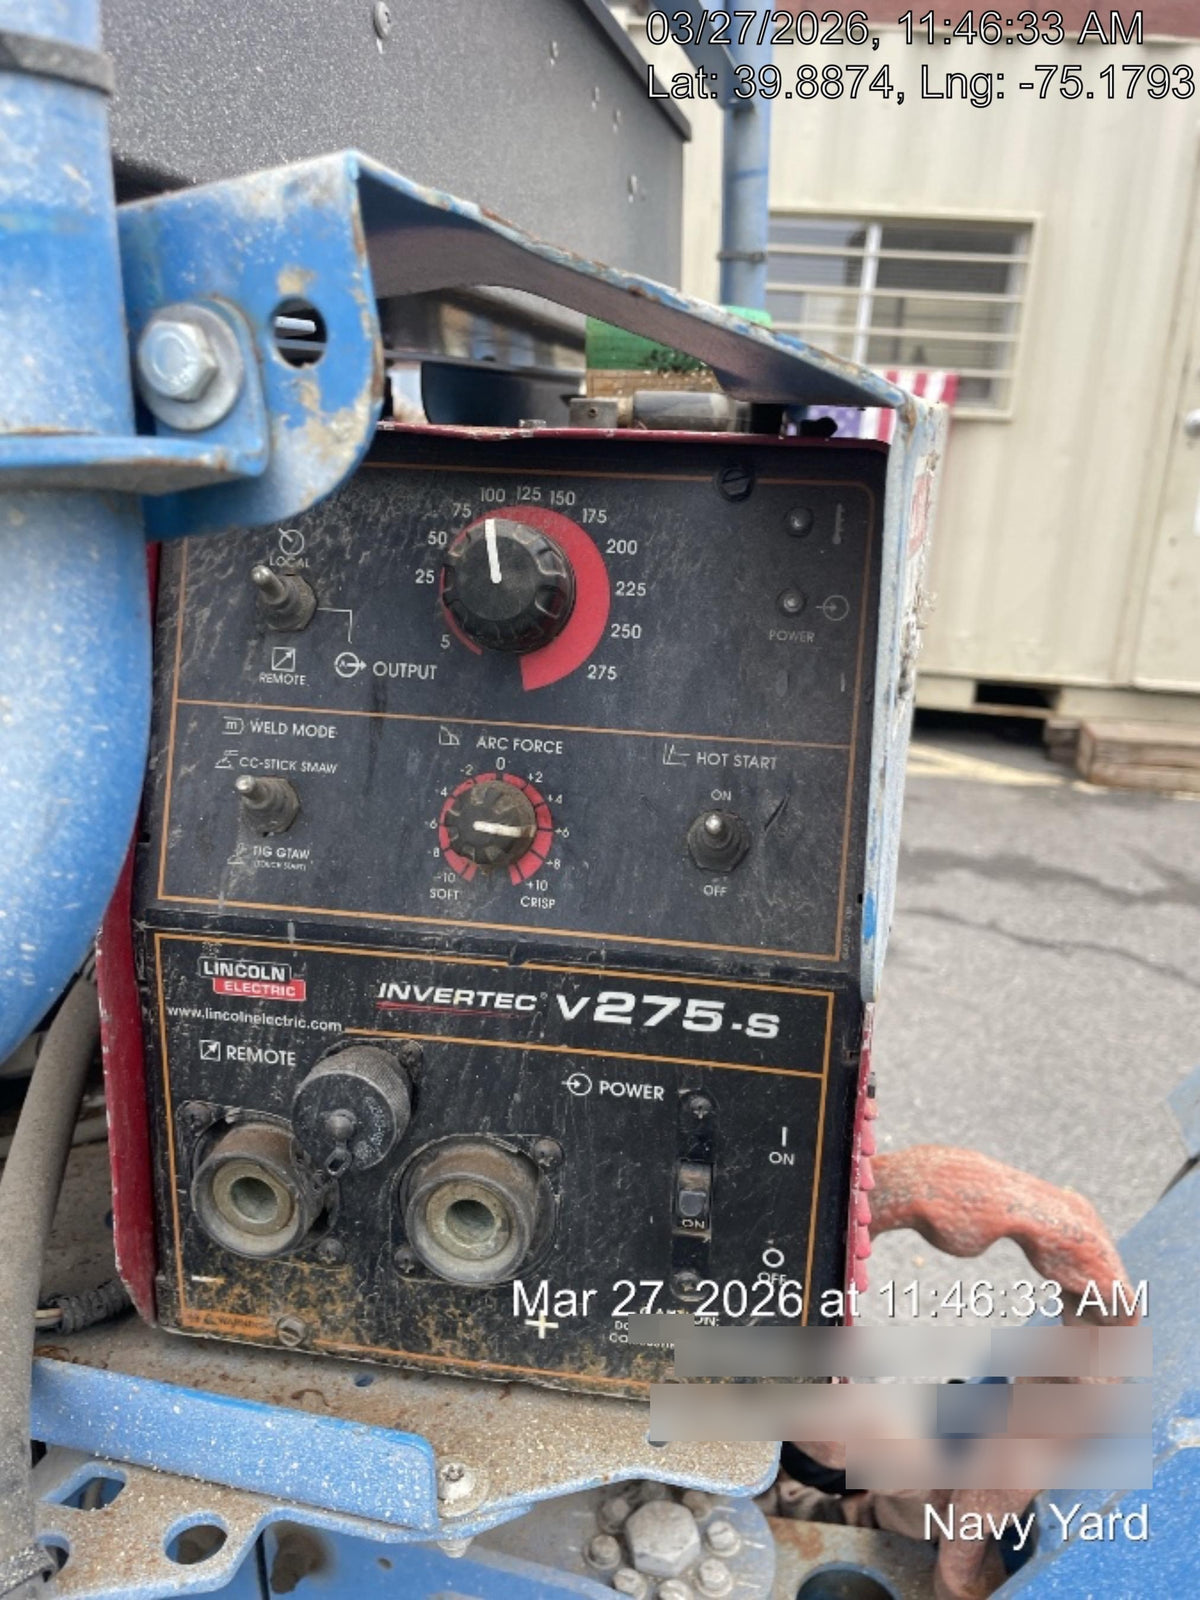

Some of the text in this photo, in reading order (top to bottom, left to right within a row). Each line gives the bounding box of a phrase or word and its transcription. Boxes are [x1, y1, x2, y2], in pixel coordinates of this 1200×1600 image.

[480, 487, 506, 502] 100
[516, 486, 541, 501] 125
[550, 489, 576, 506] 150
[452, 503, 472, 518] 75
[582, 508, 607, 523] 175
[428, 531, 448, 545] 50
[606, 540, 637, 554] 200
[269, 555, 311, 569] LOCAL
[415, 569, 435, 584] 25
[615, 581, 646, 596] 225
[610, 624, 642, 639] 250
[769, 629, 815, 643] POWER
[440, 635, 450, 649] 5
[373, 661, 437, 680] OUTPUT
[587, 665, 618, 680] 275
[259, 673, 307, 686] REMOTE
[250, 720, 337, 739] WELD MODE
[476, 736, 563, 755] ARC FORCE
[239, 757, 338, 774] CC-STICK SMAW
[496, 757, 506, 770] 0
[696, 752, 778, 770] HOT START
[528, 772, 543, 784] +2
[710, 789, 732, 801] ON
[276, 847, 310, 860] GTAW
[526, 879, 548, 892] +10
[703, 884, 728, 897] OFF
[429, 887, 460, 901] SOFT
[520, 896, 556, 910] CRISP
[203, 960, 286, 982] LINCOLN
[224, 980, 297, 997] ELECTRIC
[167, 1006, 343, 1032] www.lincolnelectric.com
[226, 1045, 297, 1067] REMOTE
[599, 1080, 665, 1102] POWER
[768, 1151, 796, 1166] ON
[681, 1218, 705, 1230] ON
